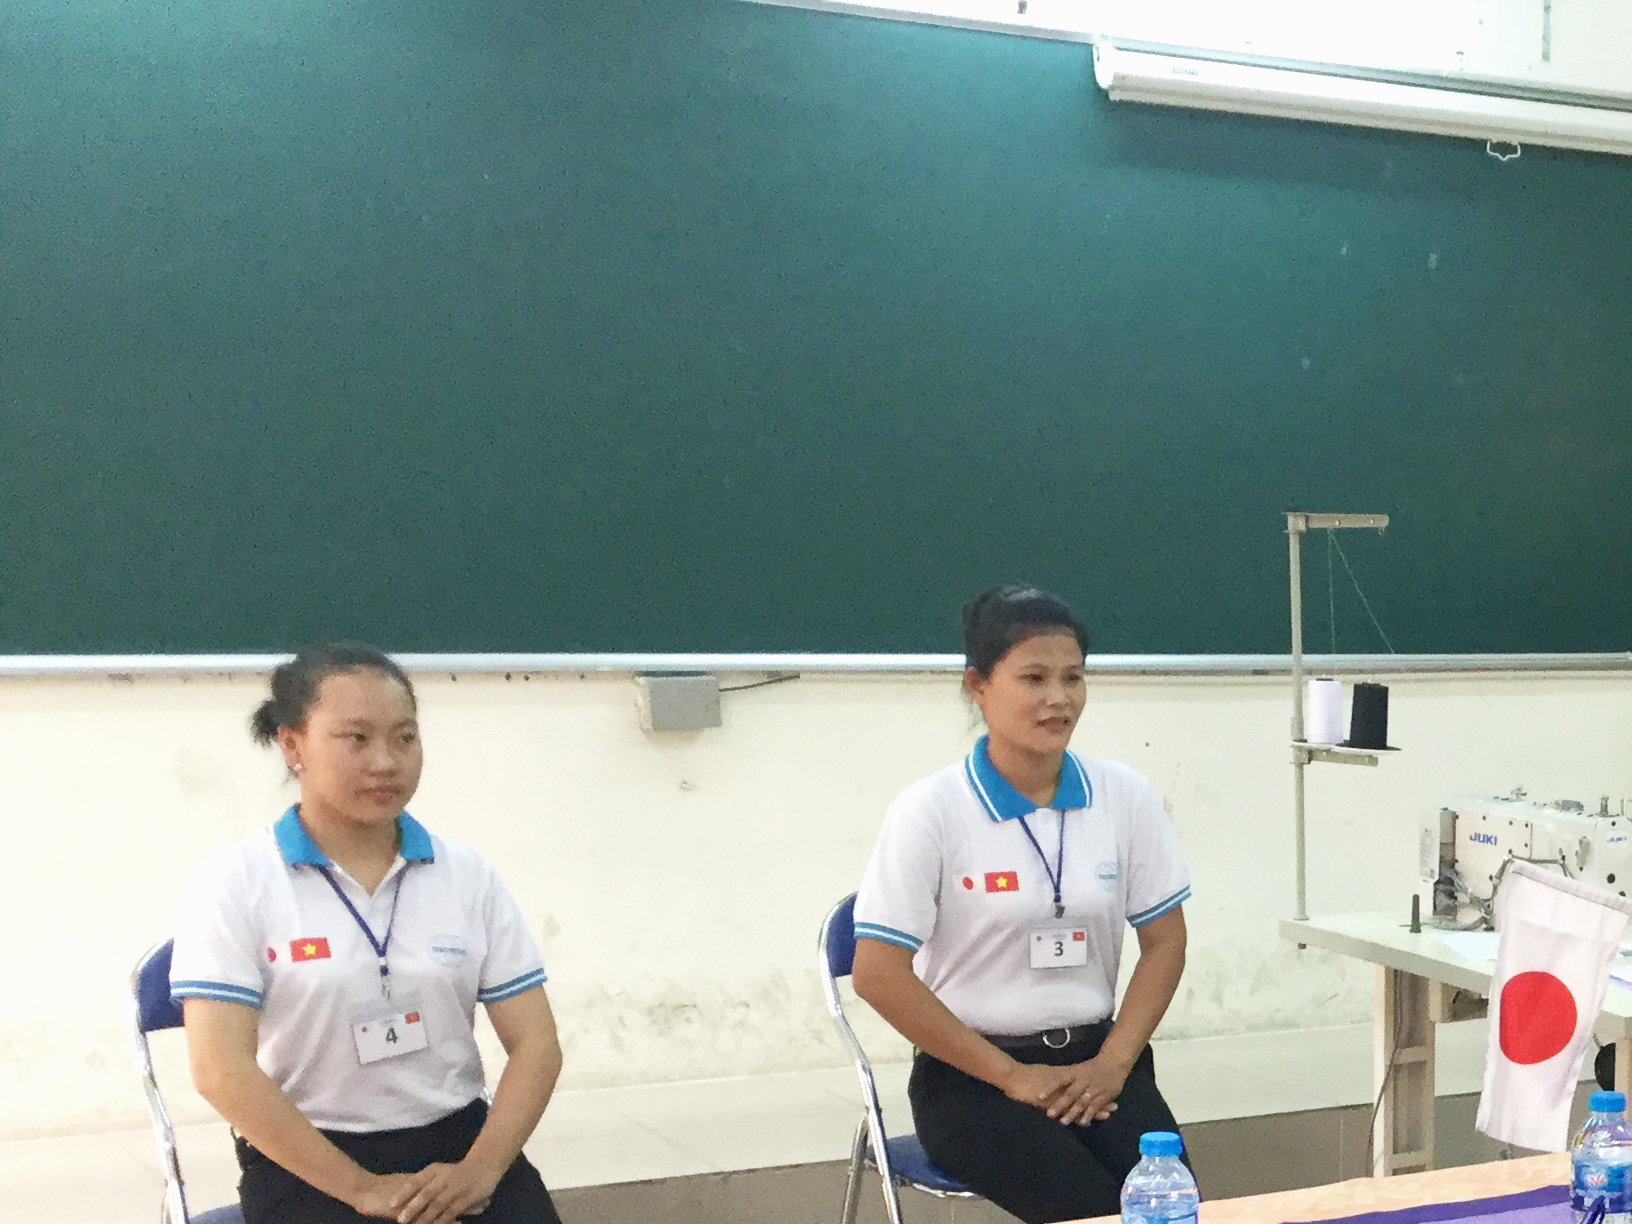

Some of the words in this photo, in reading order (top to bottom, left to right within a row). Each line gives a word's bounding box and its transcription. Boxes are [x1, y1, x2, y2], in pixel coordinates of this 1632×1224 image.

[1469, 832, 1498, 846] JUKI
[1054, 941, 1064, 957] 3
[385, 1027, 398, 1044] 4
